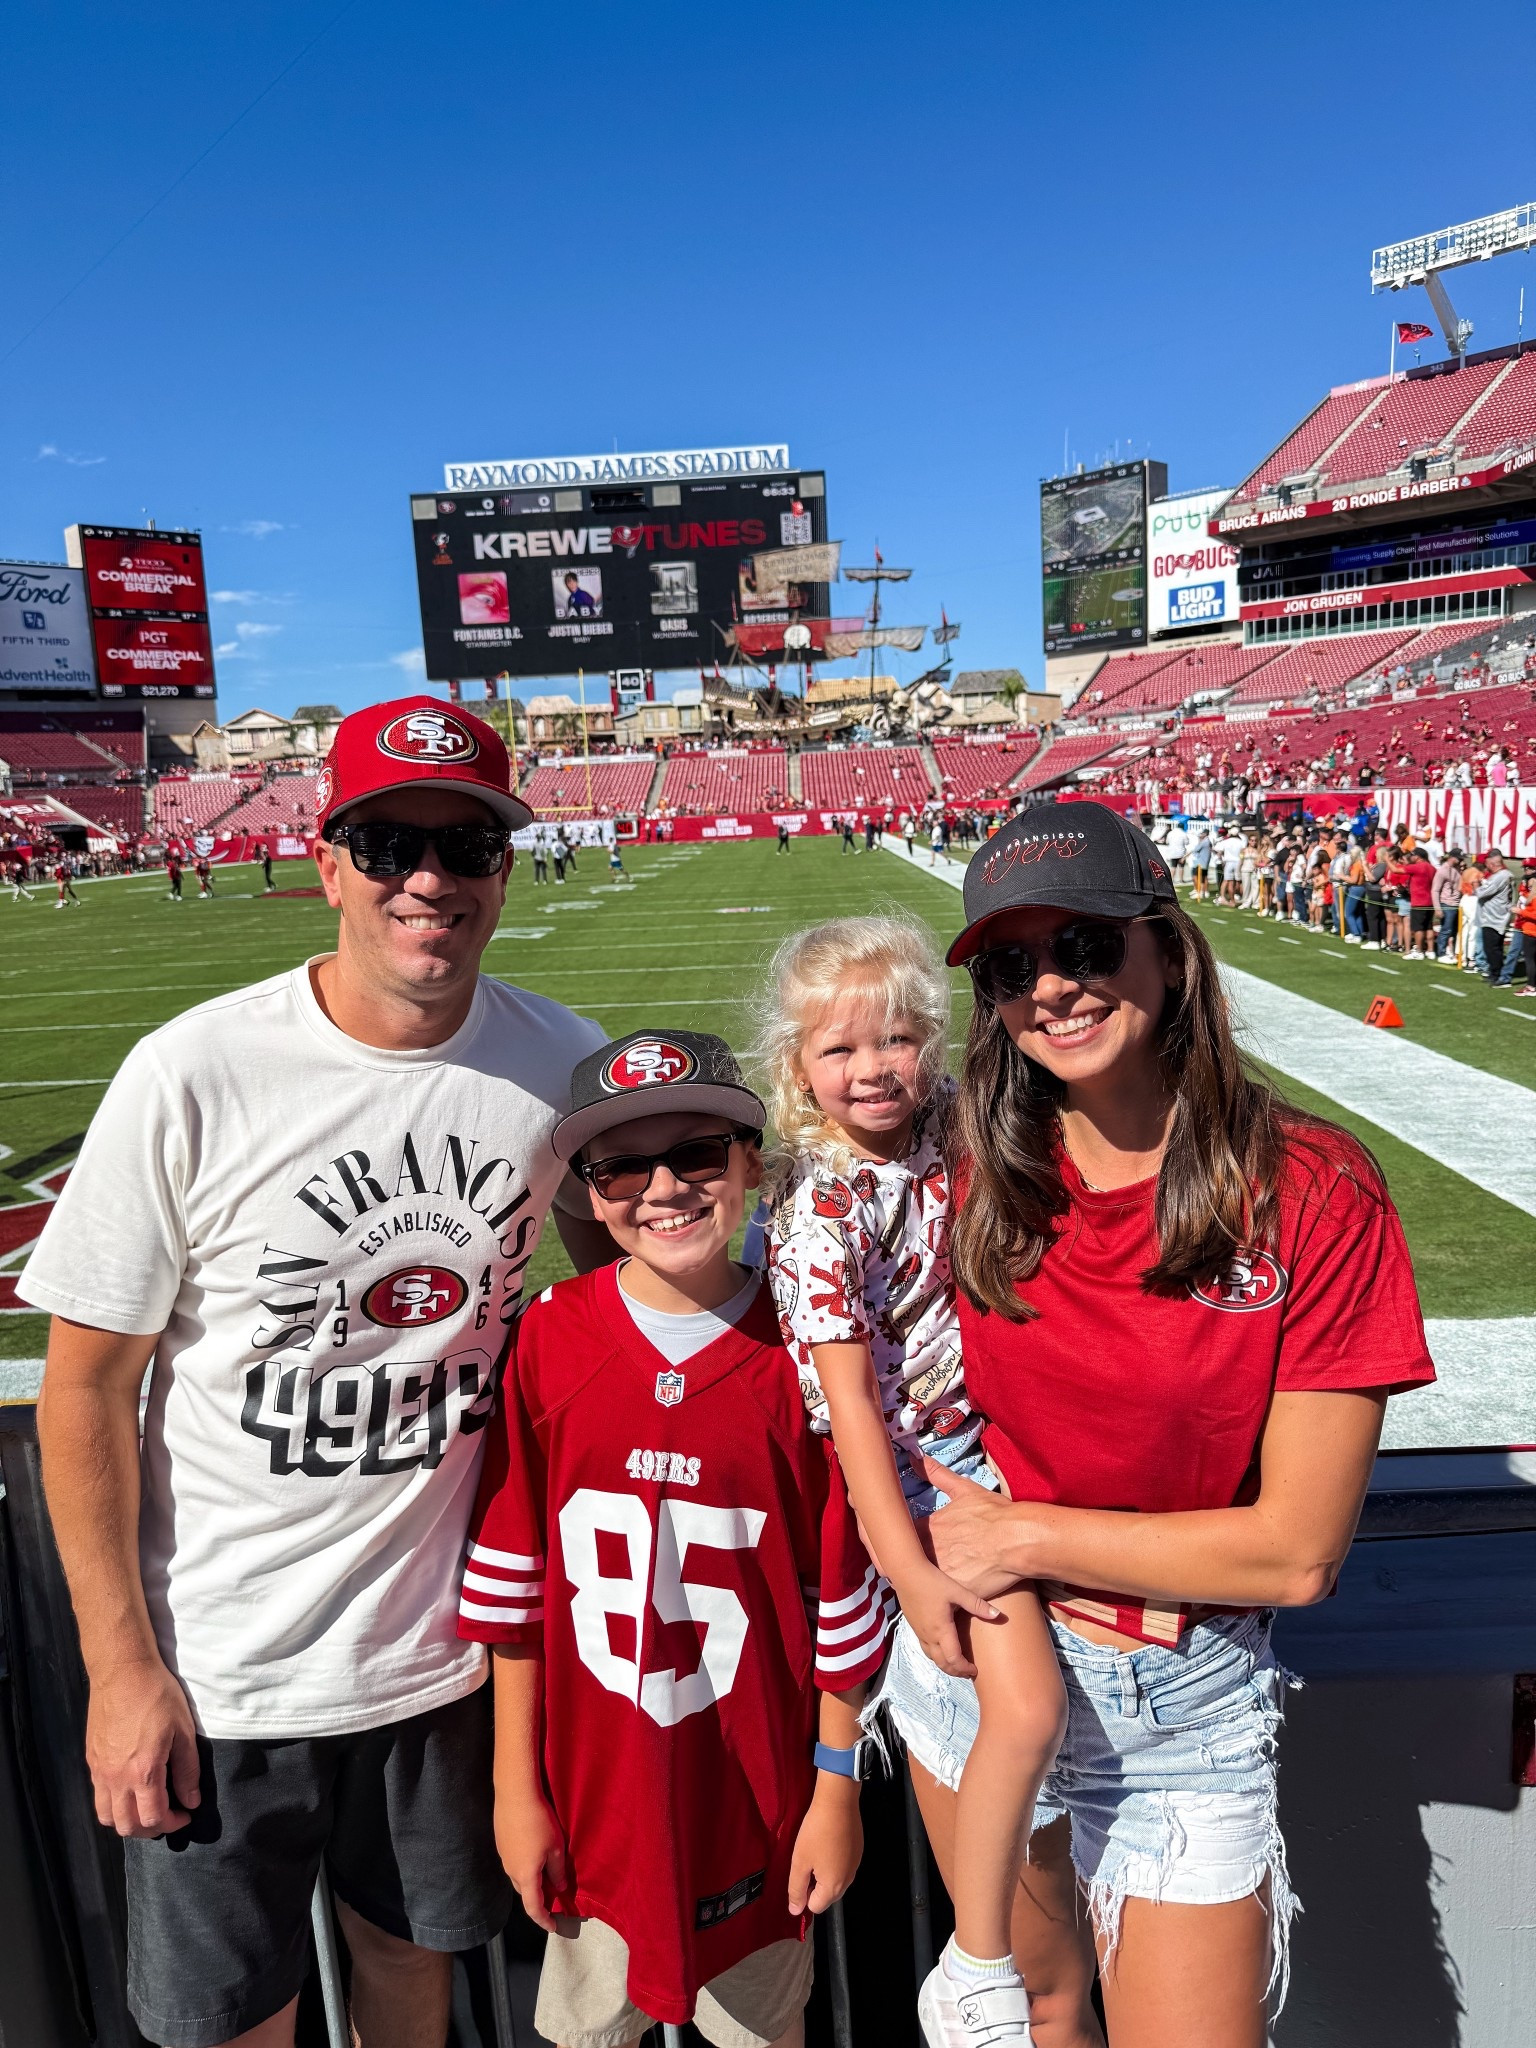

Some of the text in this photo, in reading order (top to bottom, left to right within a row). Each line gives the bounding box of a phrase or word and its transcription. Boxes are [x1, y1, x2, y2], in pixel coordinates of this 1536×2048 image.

[450, 449, 784, 488] RAYMOND JAMES STADIUM
[1513, 449, 1534, 470] JOHN
[1332, 500, 1347, 512] 20
[1400, 477, 1459, 499] BARBER
[1219, 506, 1307, 532] BRUCE ARIANS
[473, 519, 767, 560] KREWE TUNES
[1432, 536, 1483, 550] Manufacturing
[1484, 530, 1519, 542] Solutions
[1154, 544, 1239, 578] GO BUCS
[0, 571, 70, 604] Ford
[97, 570, 196, 586] COMMERCIAL
[124, 582, 173, 594] BREAK
[1178, 585, 1216, 605] BUD
[1283, 592, 1363, 613] JON GRUDEN
[555, 606, 603, 618] BABY
[1170, 599, 1222, 622] LIGHT
[453, 628, 504, 642] FONTAINES
[548, 622, 614, 637] JUSTIN BIEBER
[659, 618, 688, 632] OASIS
[2, 636, 70, 646] FIFTH THIRD
[139, 631, 168, 644] PGT
[106, 648, 204, 661] COMMERCIAL
[133, 660, 181, 670] BREAK
[622, 676, 640, 687] 40
[1454, 670, 1527, 690] GO BUCS GO BUCS
[141, 686, 179, 697] $21,270
[1225, 712, 1268, 722] BUCCANEERS
[406, 716, 463, 754] SF
[1065, 720, 1156, 737] GO BUCS GO BUCS
[616, 822, 632, 833] 40
[983, 832, 1085, 868] SAN FRANCISCO
[1366, 1000, 1385, 1023] G
[625, 1044, 681, 1086] SF
[252, 1132, 537, 1351] SAN FRANCISCO
[358, 1211, 472, 1257] ESTABLISHED
[392, 1273, 449, 1321] SF
[625, 1448, 701, 1487] 49ERS
[558, 1488, 767, 1728] 85
